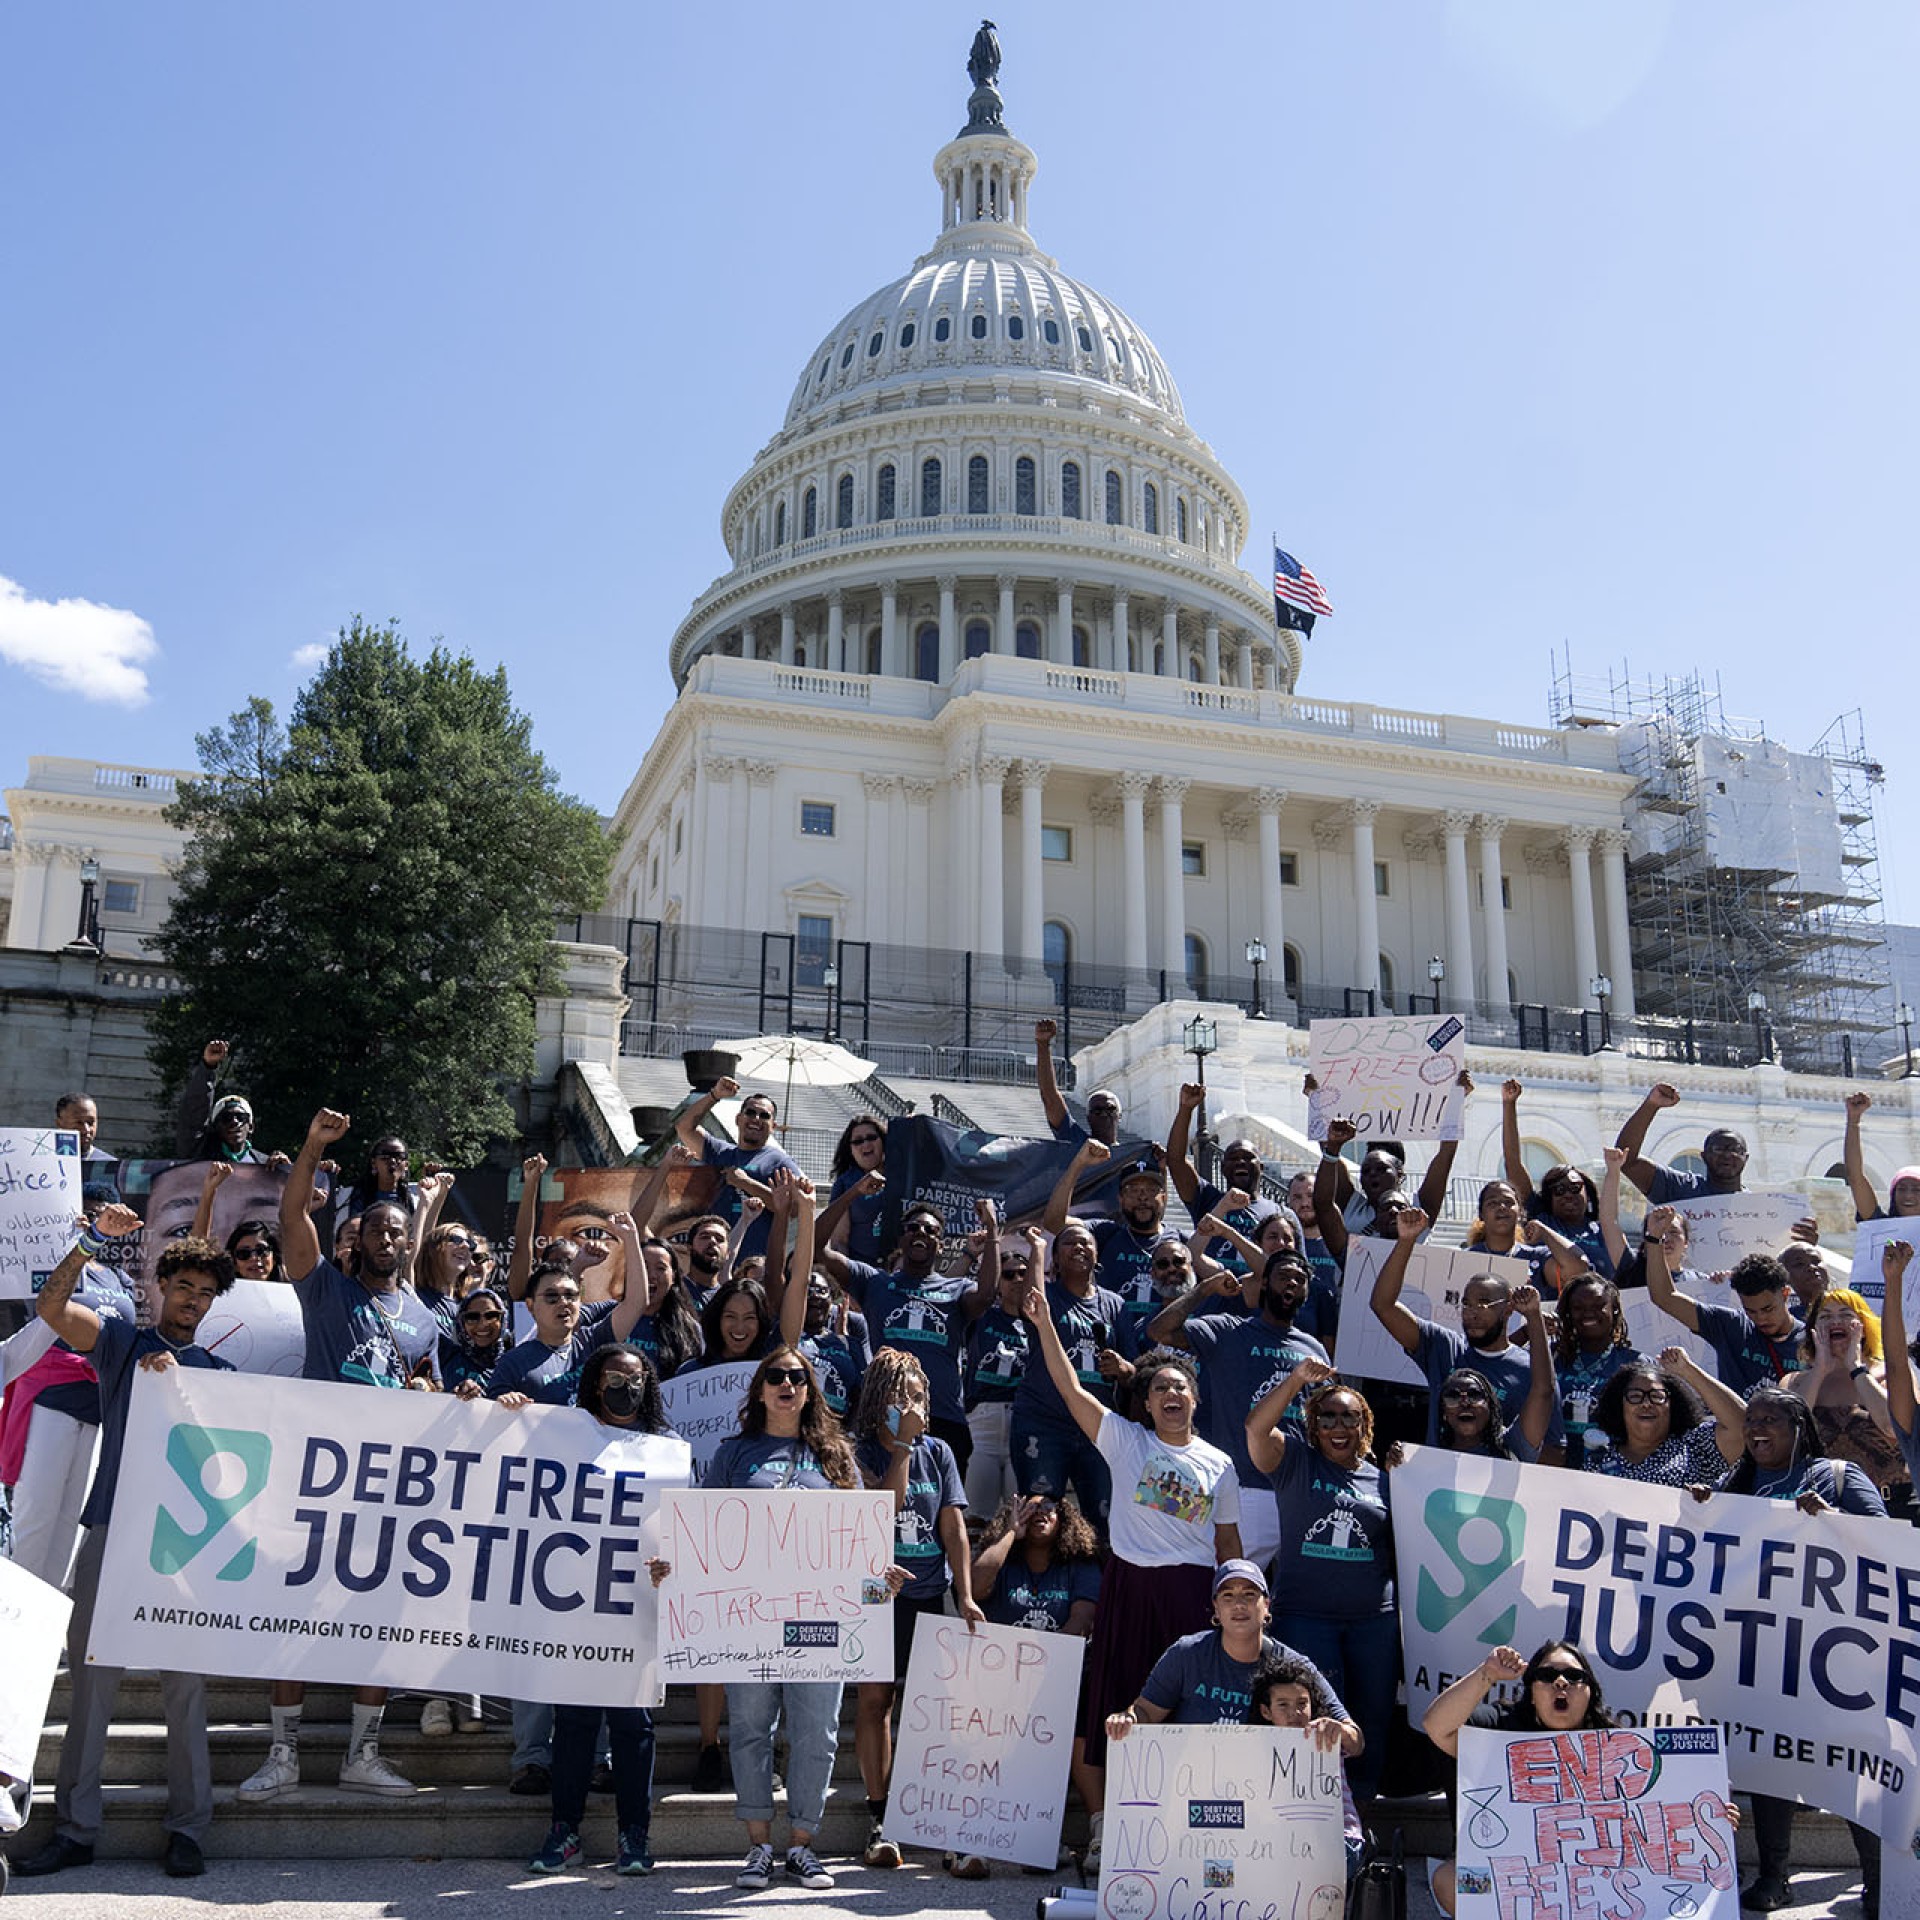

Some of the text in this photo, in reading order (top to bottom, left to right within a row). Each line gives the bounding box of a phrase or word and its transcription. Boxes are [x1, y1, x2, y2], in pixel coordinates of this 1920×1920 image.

[1320, 1020, 1439, 1055] DEBT
[1319, 1055, 1419, 1088] FREE
[1337, 1092, 1447, 1134] OW!!!
[1360, 1086, 1405, 1111] IS
[916, 1187, 975, 1208] PARENTS
[96, 1245, 152, 1261] RSON.
[299, 1436, 646, 1527] DEBT FREE
[1312, 1479, 1321, 1490] A
[284, 1508, 640, 1615] JUSTICE
[1555, 1508, 1920, 1632] DEBT FREE
[696, 1585, 862, 1629] TARIFAS
[133, 1606, 634, 1663] A NATIONAL CAMPAIGN TO END FEES & FINES FOR YOUTH
[798, 1633, 837, 1643] JUSTICE
[819, 1626, 836, 1634] FREE
[934, 1627, 1048, 1682] STOP
[1552, 1579, 1920, 1729] JUSTICE
[1195, 1683, 1252, 1706] A FUTU
[1415, 1665, 1430, 1691] A
[909, 1694, 1054, 1744] STEALING
[1672, 1733, 1693, 1741] DEBT
[1671, 1740, 1717, 1750] JUSTICE
[1773, 1733, 1815, 1764] BE
[1826, 1744, 1904, 1794] FINED
[921, 1744, 1000, 1787] FROM
[1119, 1740, 1164, 1800] NO
[1176, 1764, 1198, 1798] a
[1269, 1746, 1341, 1800] Multas
[900, 1783, 1030, 1822] CHILDREN
[1202, 1813, 1243, 1824] JUSTICE
[1224, 1806, 1242, 1814] FREE
[913, 1818, 946, 1845] they
[1113, 1817, 1169, 1868] NO
[1178, 1831, 1239, 1860] niños
[1247, 1840, 1272, 1860] en
[1534, 1791, 1735, 1890] FINES
